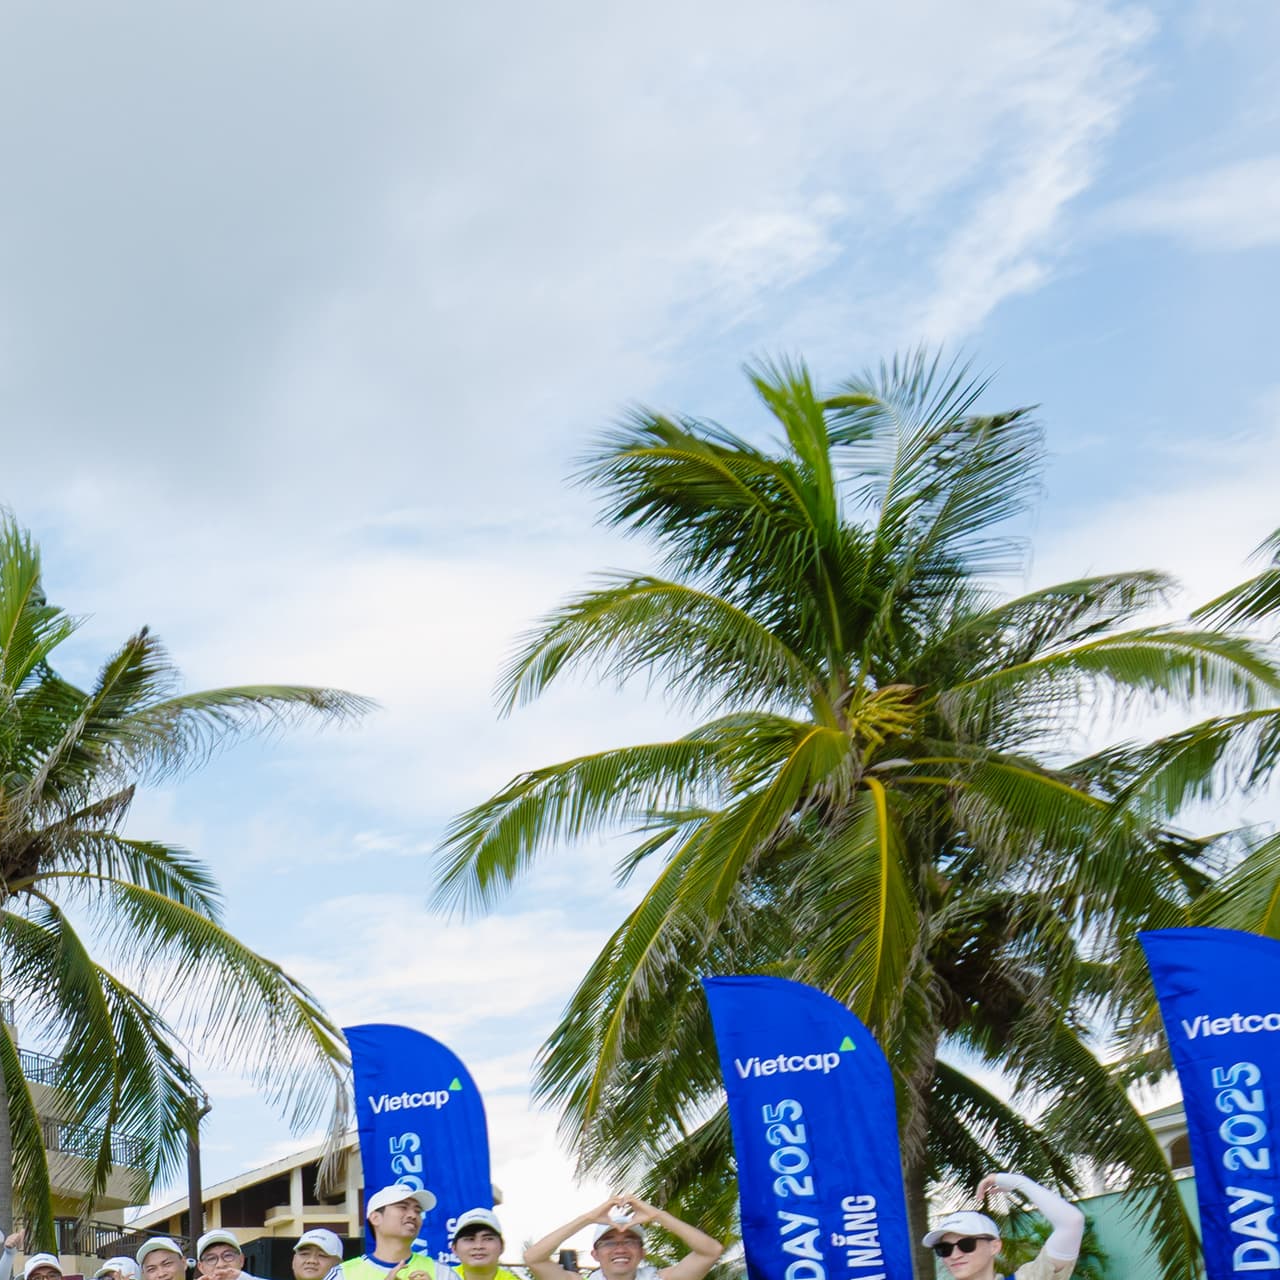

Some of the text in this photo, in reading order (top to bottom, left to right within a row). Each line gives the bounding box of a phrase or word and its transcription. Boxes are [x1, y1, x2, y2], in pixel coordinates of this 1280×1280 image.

[1181, 1012, 1280, 1040] Vietca
[734, 1051, 841, 1079] Vietcap
[368, 1089, 450, 1115] Vietcap
[1211, 1061, 1271, 1171] 2025
[762, 1099, 816, 1198] 2025
[1225, 1186, 1280, 1272] DAY
